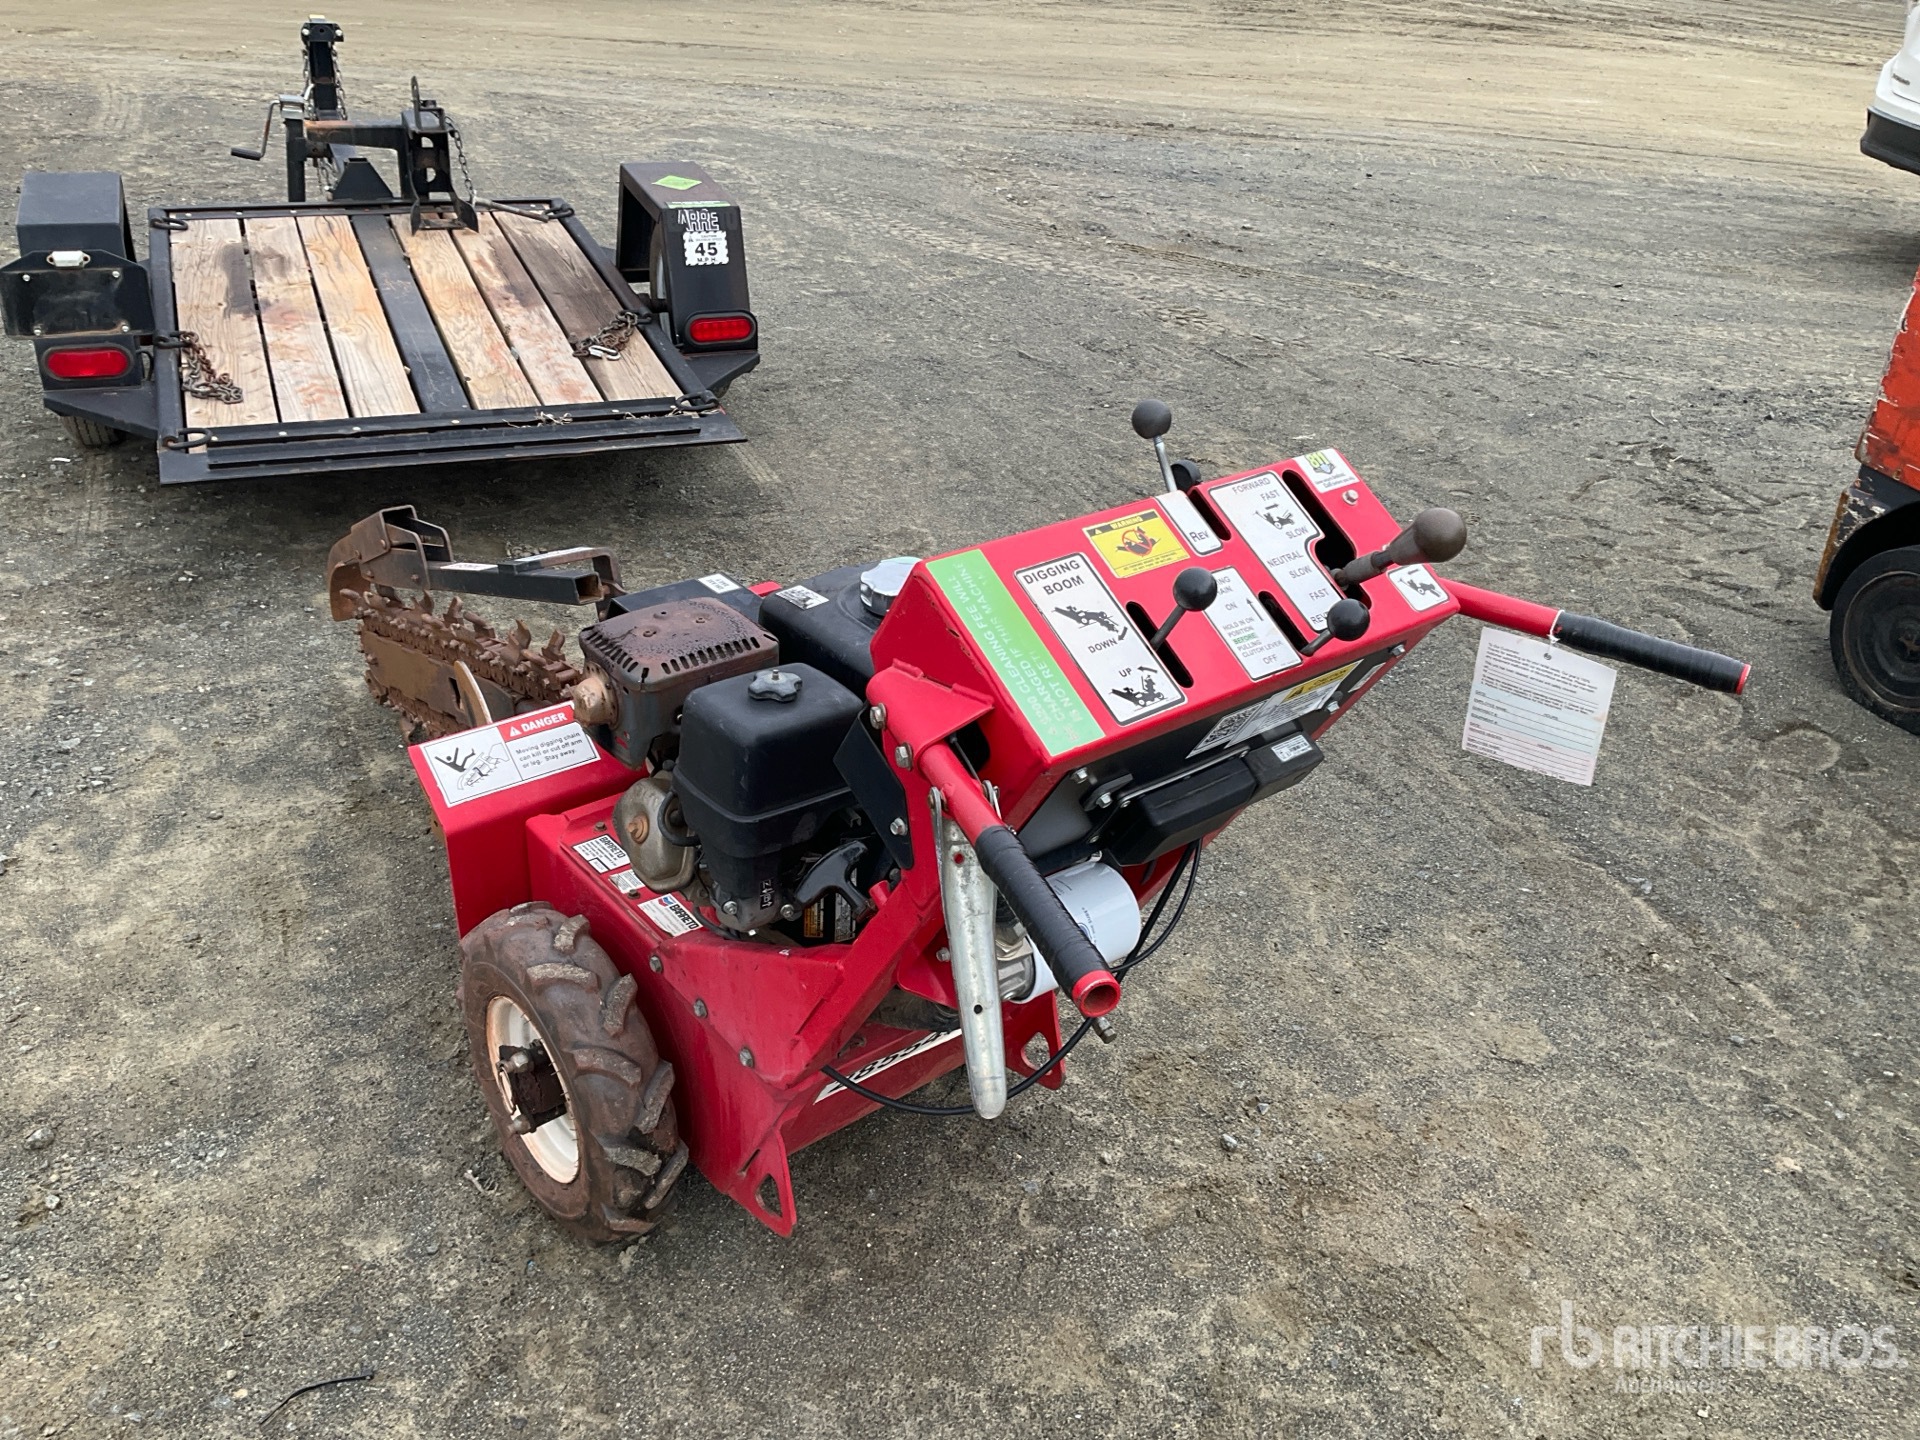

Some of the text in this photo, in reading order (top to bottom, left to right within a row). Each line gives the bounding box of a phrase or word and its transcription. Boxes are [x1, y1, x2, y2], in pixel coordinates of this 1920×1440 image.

[695, 242, 718, 256] 45
[1305, 451, 1330, 468] 811
[1232, 478, 1271, 495] FORWARD
[1260, 490, 1280, 501] FAST
[1285, 526, 1309, 540] SLOW
[1267, 551, 1304, 568] NEUTRAL
[1022, 560, 1080, 584] DIGGING
[1289, 566, 1312, 579] SLOW
[945, 574, 971, 603] WILL
[952, 561, 995, 614] MACHINE
[1043, 575, 1084, 595] BOOM
[1308, 588, 1330, 601] FAST
[1225, 602, 1238, 611] ON
[965, 604, 988, 628] FEE
[989, 615, 1014, 643] THIS
[1222, 621, 1239, 631] HOLD
[1227, 626, 1254, 638] POSITION
[1088, 638, 1118, 654] DOWN
[1233, 633, 1256, 645] BEFORE
[1237, 640, 1262, 652] PULLING
[1242, 640, 1284, 658] CLUTCH LEVER
[982, 629, 1032, 693] CLEANING
[1262, 654, 1278, 665] OFF
[1119, 668, 1132, 678] UP
[1018, 659, 1066, 721] CHARGED
[1048, 679, 1073, 707] NOT
[521, 712, 568, 732] DANGER
[516, 732, 580, 754] Moving digging chain
[532, 750, 542, 758] kill
[544, 753, 559, 761] Stay
[600, 837, 626, 858] BARRETO
[670, 903, 699, 929] BARRETO
